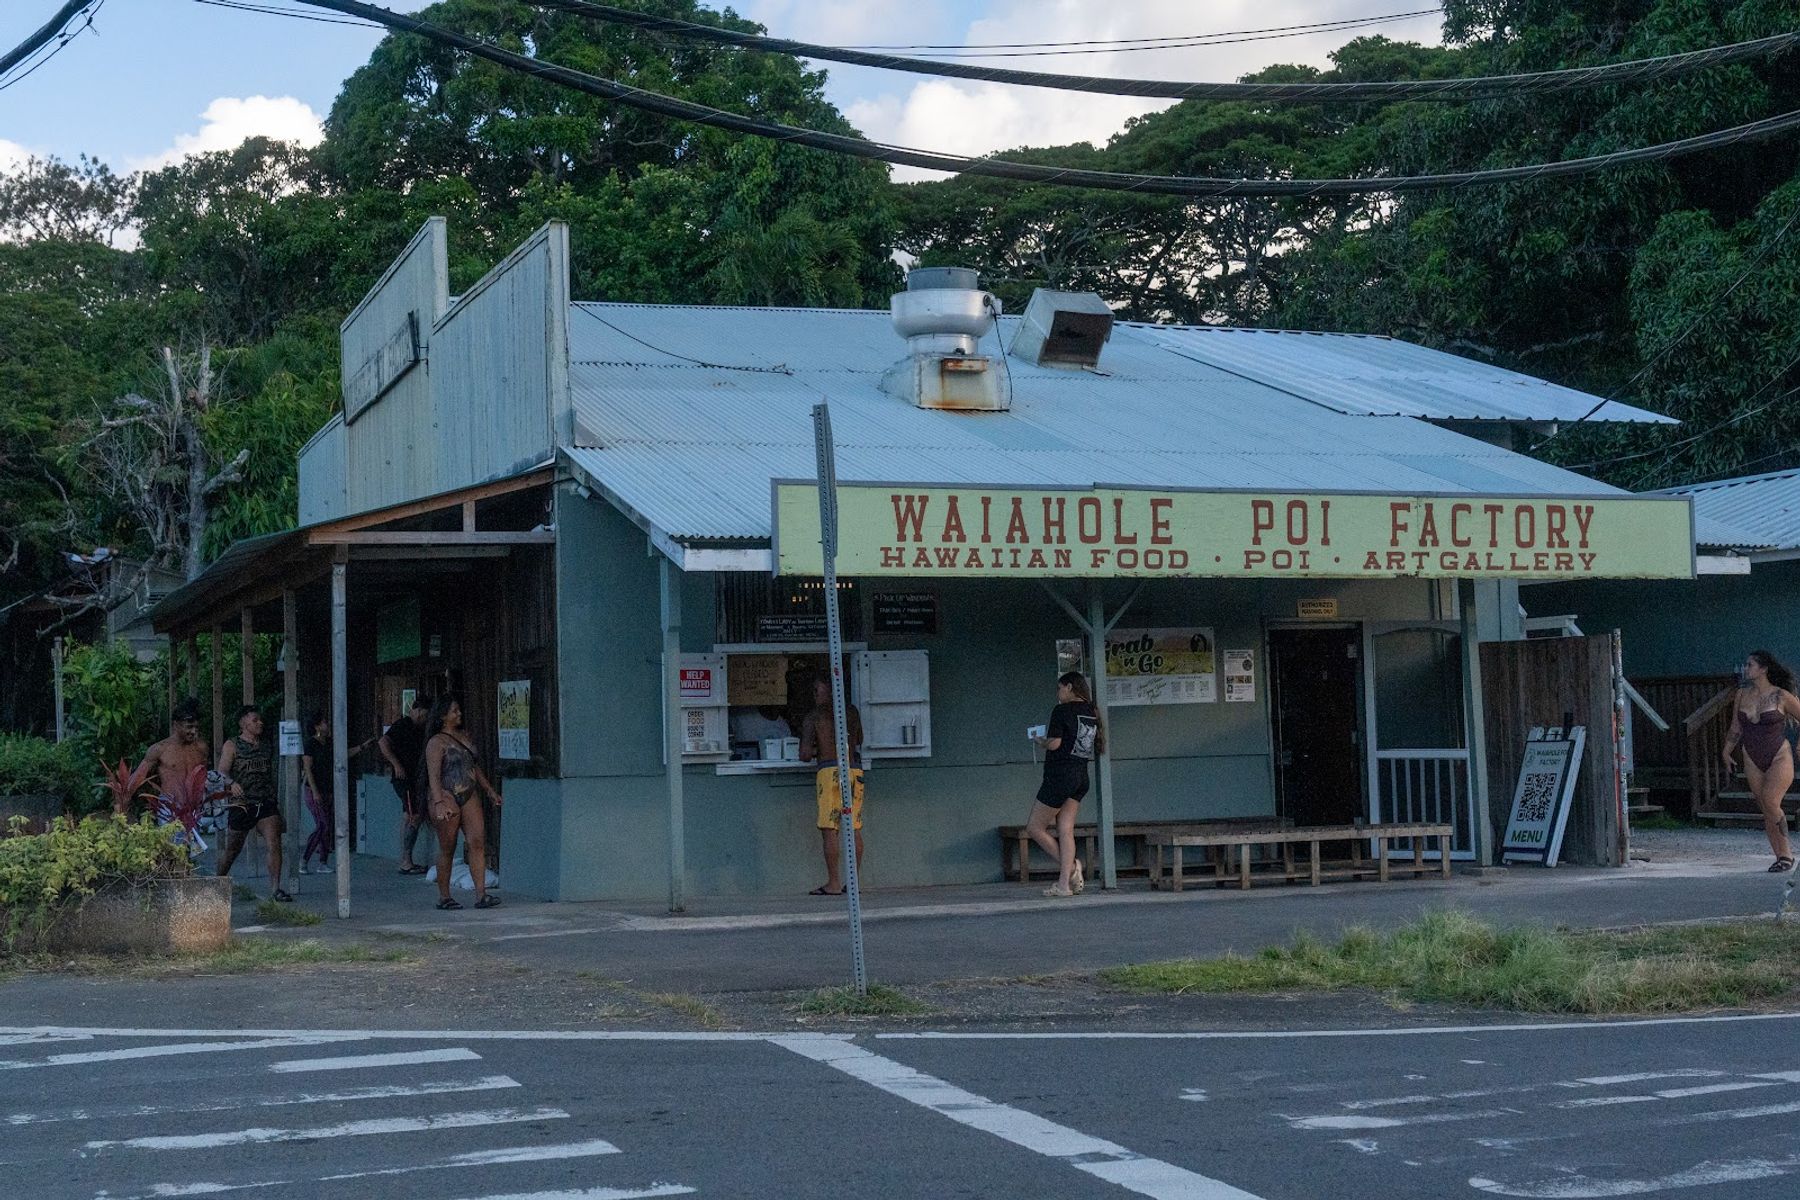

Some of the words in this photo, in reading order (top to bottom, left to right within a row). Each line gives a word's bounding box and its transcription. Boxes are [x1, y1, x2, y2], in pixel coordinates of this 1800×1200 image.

[891, 495, 1173, 545] WAIAHOLE
[1251, 499, 1330, 546] POI
[1389, 502, 1595, 549] FACTORY
[880, 547, 1072, 568] HAWAIIAN
[1090, 548, 1189, 570] FOOD
[1243, 550, 1310, 570] POI
[1363, 551, 1430, 570] ART
[1439, 551, 1597, 571] GALLERY
[1138, 653, 1164, 674] Go
[686, 671, 705, 680] HELP
[680, 680, 710, 689] WANTED
[687, 710, 705, 718] ORDER
[1511, 829, 1544, 843] MENU
